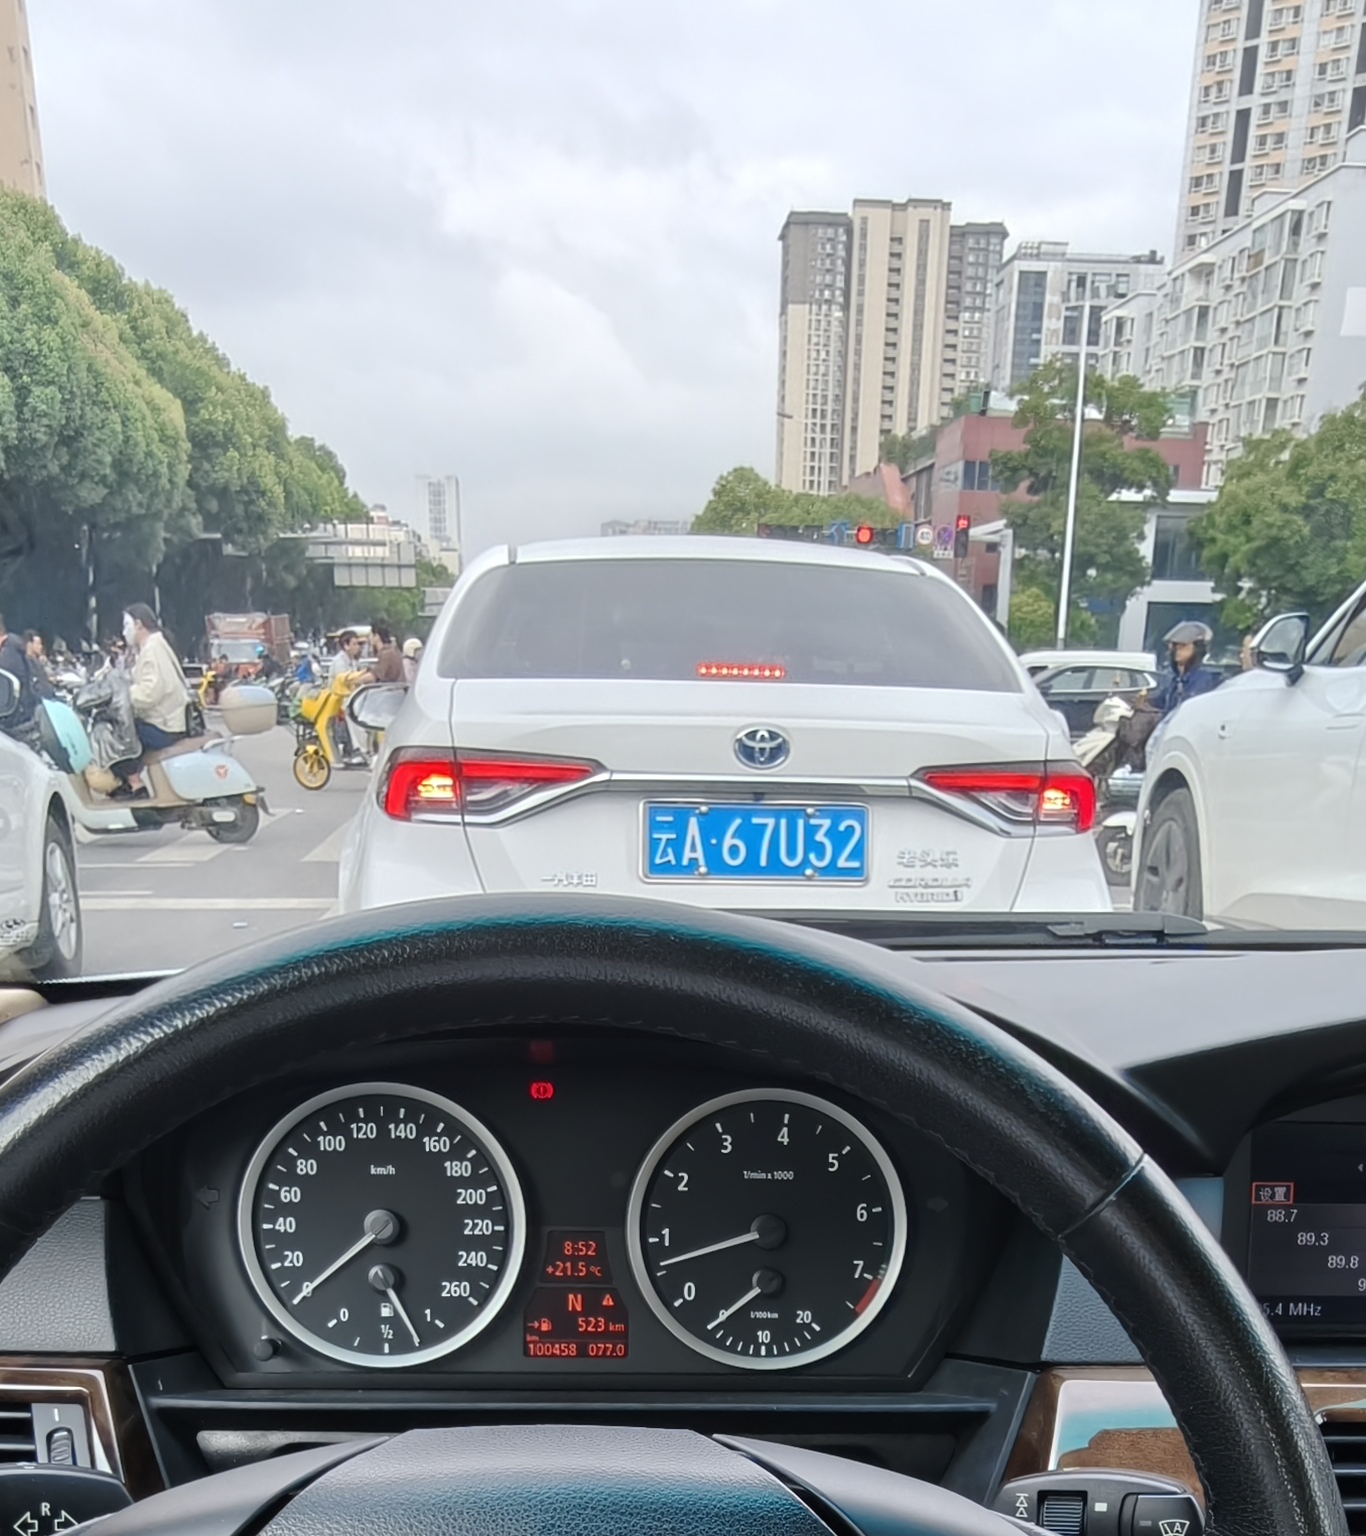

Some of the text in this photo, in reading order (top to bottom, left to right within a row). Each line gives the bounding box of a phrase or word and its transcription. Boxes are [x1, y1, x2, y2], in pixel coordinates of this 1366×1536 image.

[350, 1123, 377, 1139] 120
[388, 1123, 417, 1140] 140
[777, 1126, 790, 1145] 4
[317, 1135, 345, 1152] 100
[423, 1136, 450, 1153] 160
[721, 1135, 733, 1154] 3
[296, 1159, 317, 1175] 80
[370, 1164, 396, 1175] km/h
[444, 1161, 472, 1177] 180
[828, 1153, 839, 1172] 5
[677, 1172, 689, 1191] 2
[773, 1170, 794, 1180] 1000
[280, 1186, 301, 1203] 60
[456, 1188, 486, 1205] 200
[1259, 1186, 1287, 1202] 设置
[856, 1203, 868, 1222] 6
[1267, 1209, 1298, 1223] 88.7
[275, 1216, 296, 1233] 40
[463, 1219, 492, 1235] 220
[661, 1228, 670, 1246] 1
[1297, 1232, 1329, 1246] 89.3
[564, 1241, 596, 1256] 8:52
[284, 1251, 303, 1267] 20
[458, 1251, 487, 1267] 240
[1327, 1255, 1359, 1269] 89.8
[546, 1261, 587, 1276] +21.5
[853, 1260, 864, 1279] 7
[441, 1281, 470, 1298] 260
[683, 1281, 696, 1301] 0
[568, 1293, 582, 1312] N
[1261, 1302, 1321, 1316] 5.4 MHz
[339, 1307, 349, 1321] 0
[424, 1308, 431, 1322] 1
[796, 1311, 812, 1324] 20
[578, 1317, 625, 1332] 523 km
[757, 1330, 770, 1343] 10
[528, 1343, 625, 1356] 100458 077.0
[41, 1502, 51, 1517] R
